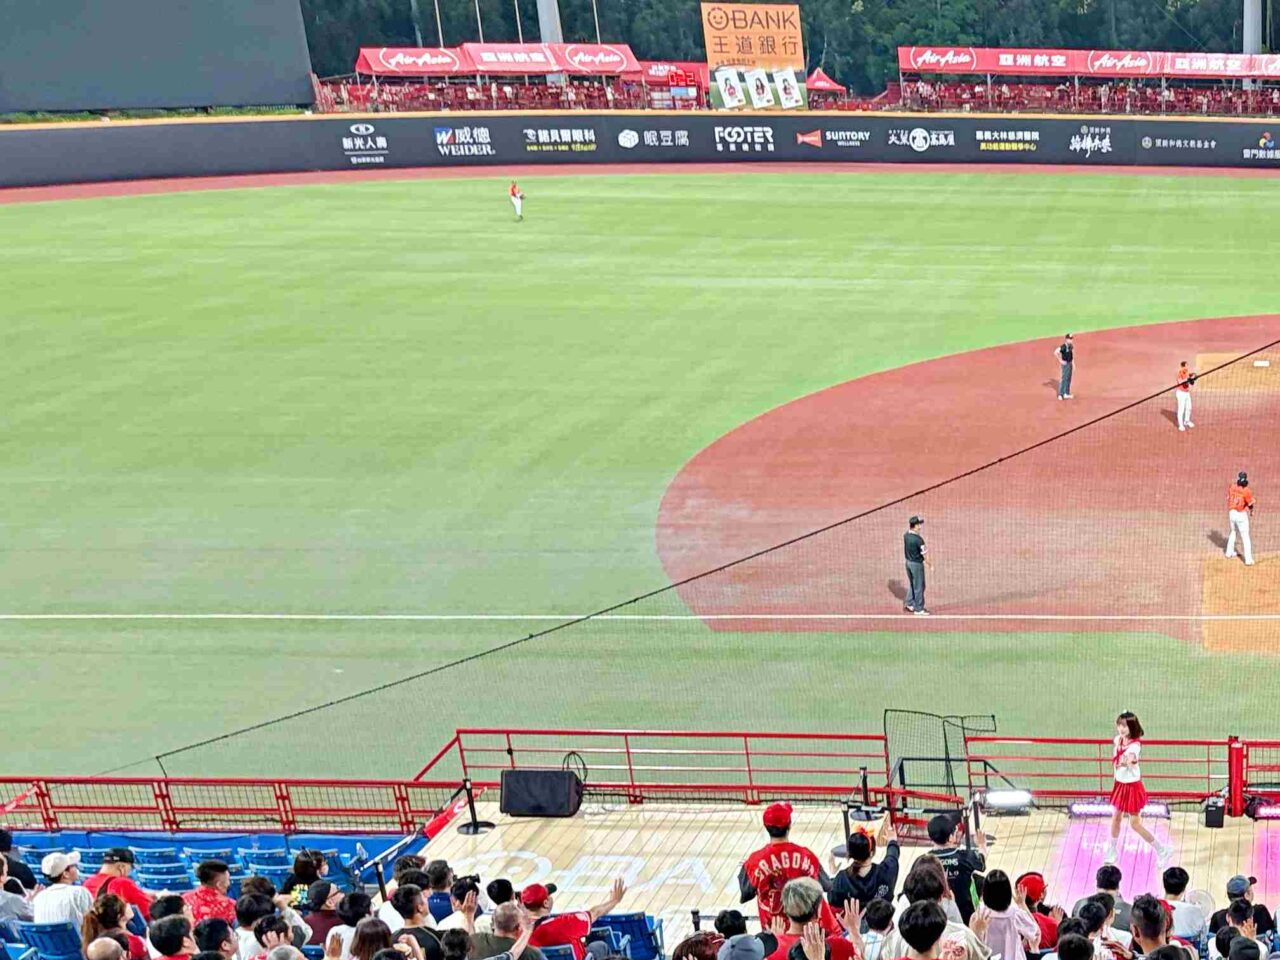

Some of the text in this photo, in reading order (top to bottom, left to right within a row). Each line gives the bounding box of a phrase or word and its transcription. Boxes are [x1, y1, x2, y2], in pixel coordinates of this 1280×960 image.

[712, 35, 800, 56] 王道銀行
[388, 53, 453, 67] AirAsia
[573, 51, 621, 66] AirAsia
[917, 50, 971, 67] AirAsia
[998, 54, 1067, 67] 亞洲航空
[1094, 54, 1148, 71] AirAsia
[643, 129, 690, 147] 眠豆腐
[714, 126, 774, 143] FOOTER
